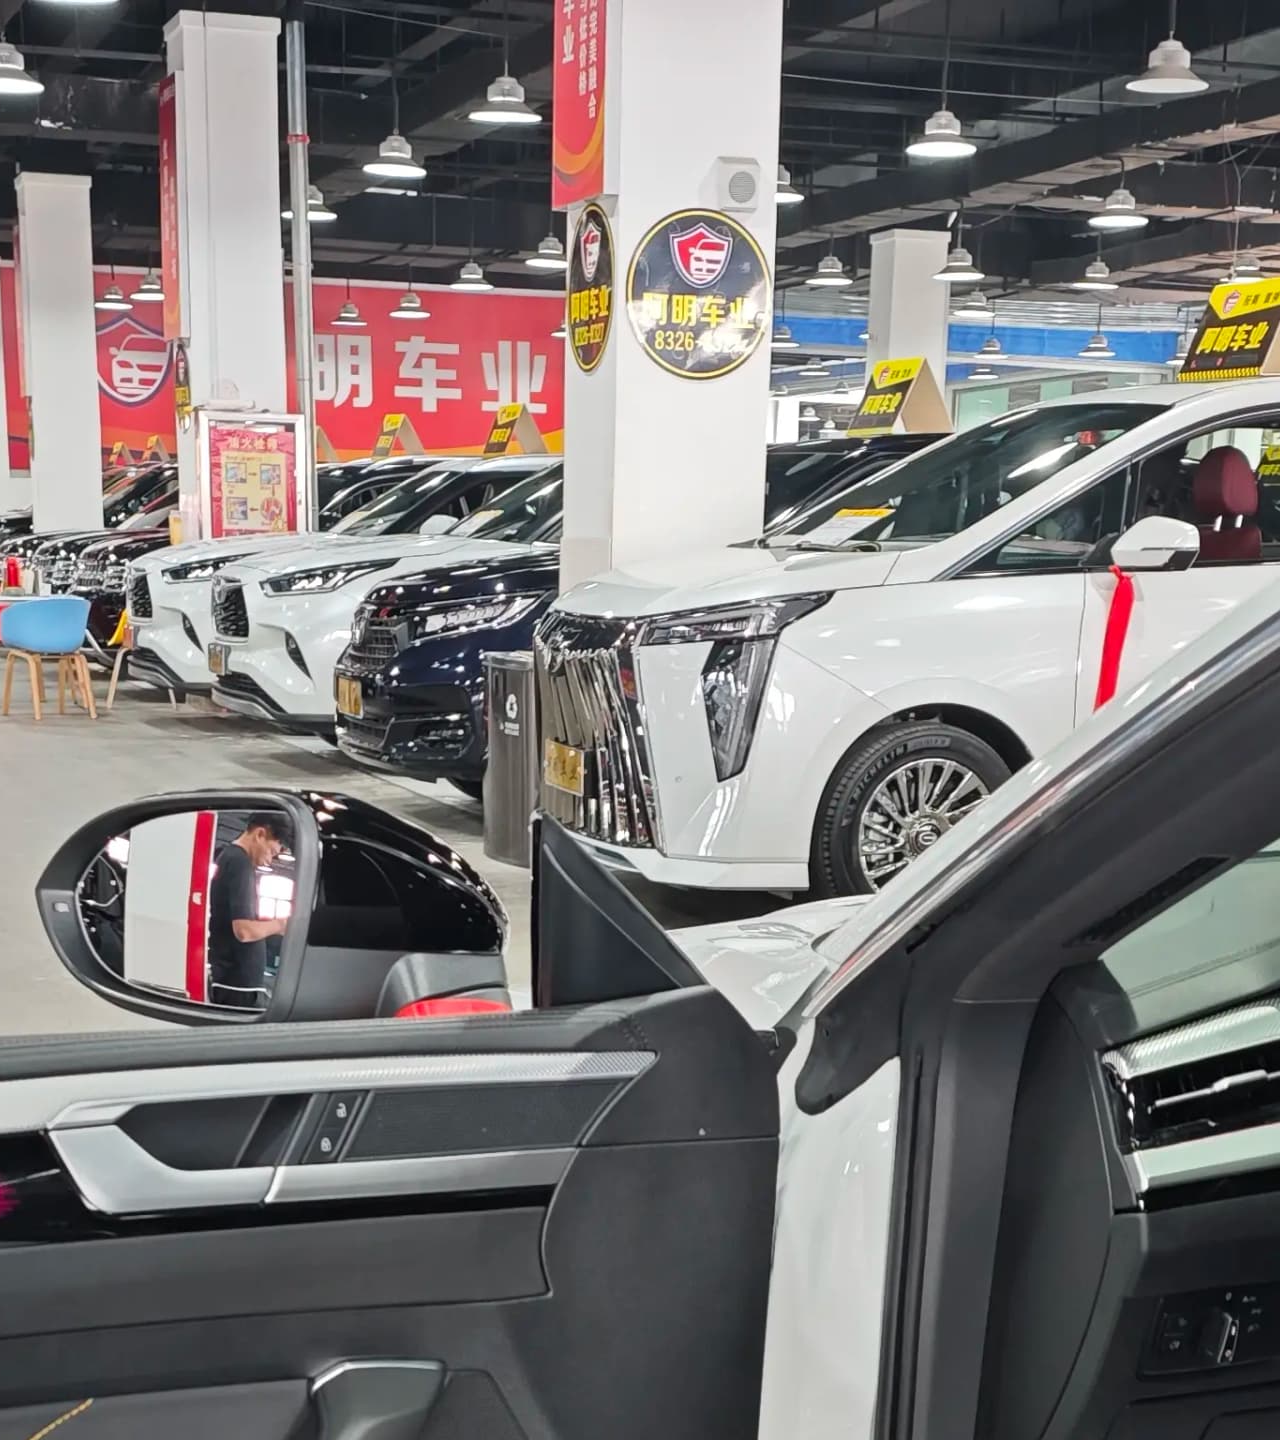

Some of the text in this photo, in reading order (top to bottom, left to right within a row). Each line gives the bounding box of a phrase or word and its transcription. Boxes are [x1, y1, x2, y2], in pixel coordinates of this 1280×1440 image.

[641, 291, 754, 329] 阿明车业
[1195, 320, 1270, 355] 阿明车业
